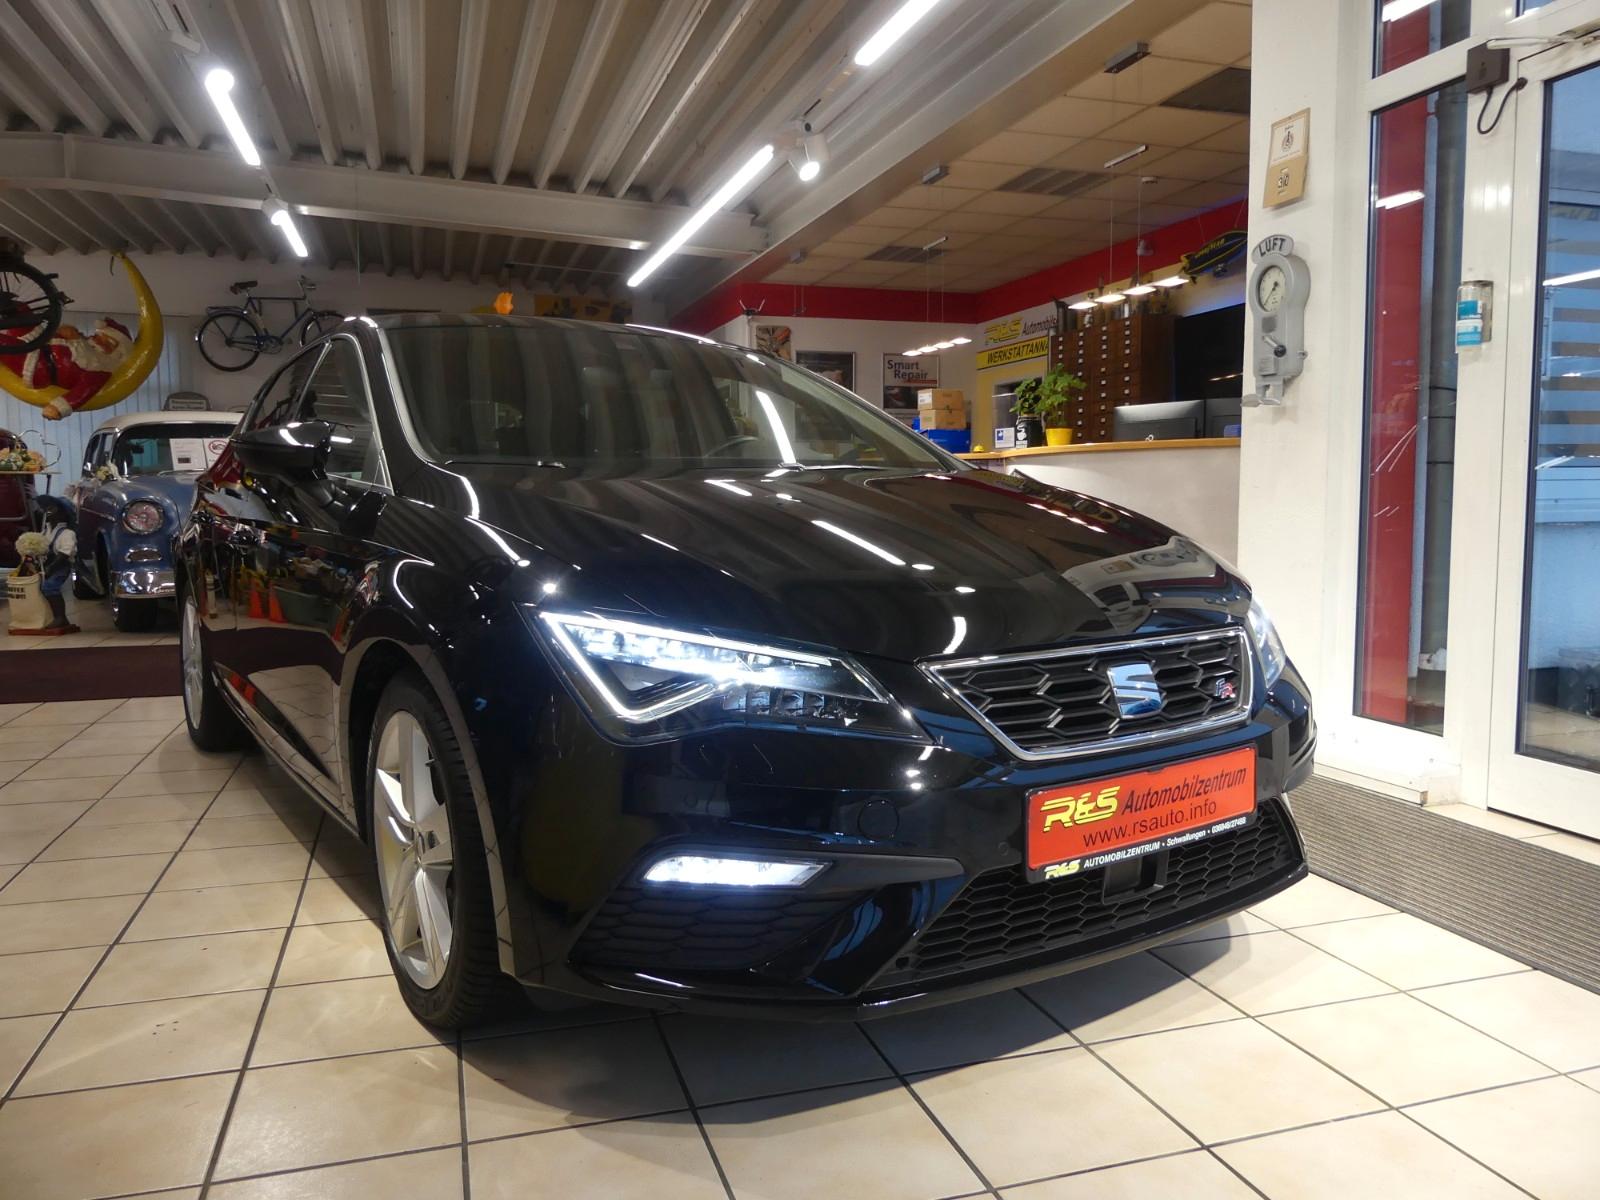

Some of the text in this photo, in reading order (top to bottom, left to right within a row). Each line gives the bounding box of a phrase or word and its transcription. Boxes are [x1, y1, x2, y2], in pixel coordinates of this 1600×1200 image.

[1258, 237, 1286, 258] LUFT
[887, 359, 919, 371] Smart
[893, 368, 929, 382] Repair
[1040, 767, 1247, 832] R&S Automobilzentrum
[1082, 798, 1217, 848] www.rsauto.info
[1044, 859, 1081, 880] R&S
[1083, 841, 1161, 869] AUTOMOBILZENTRUM
